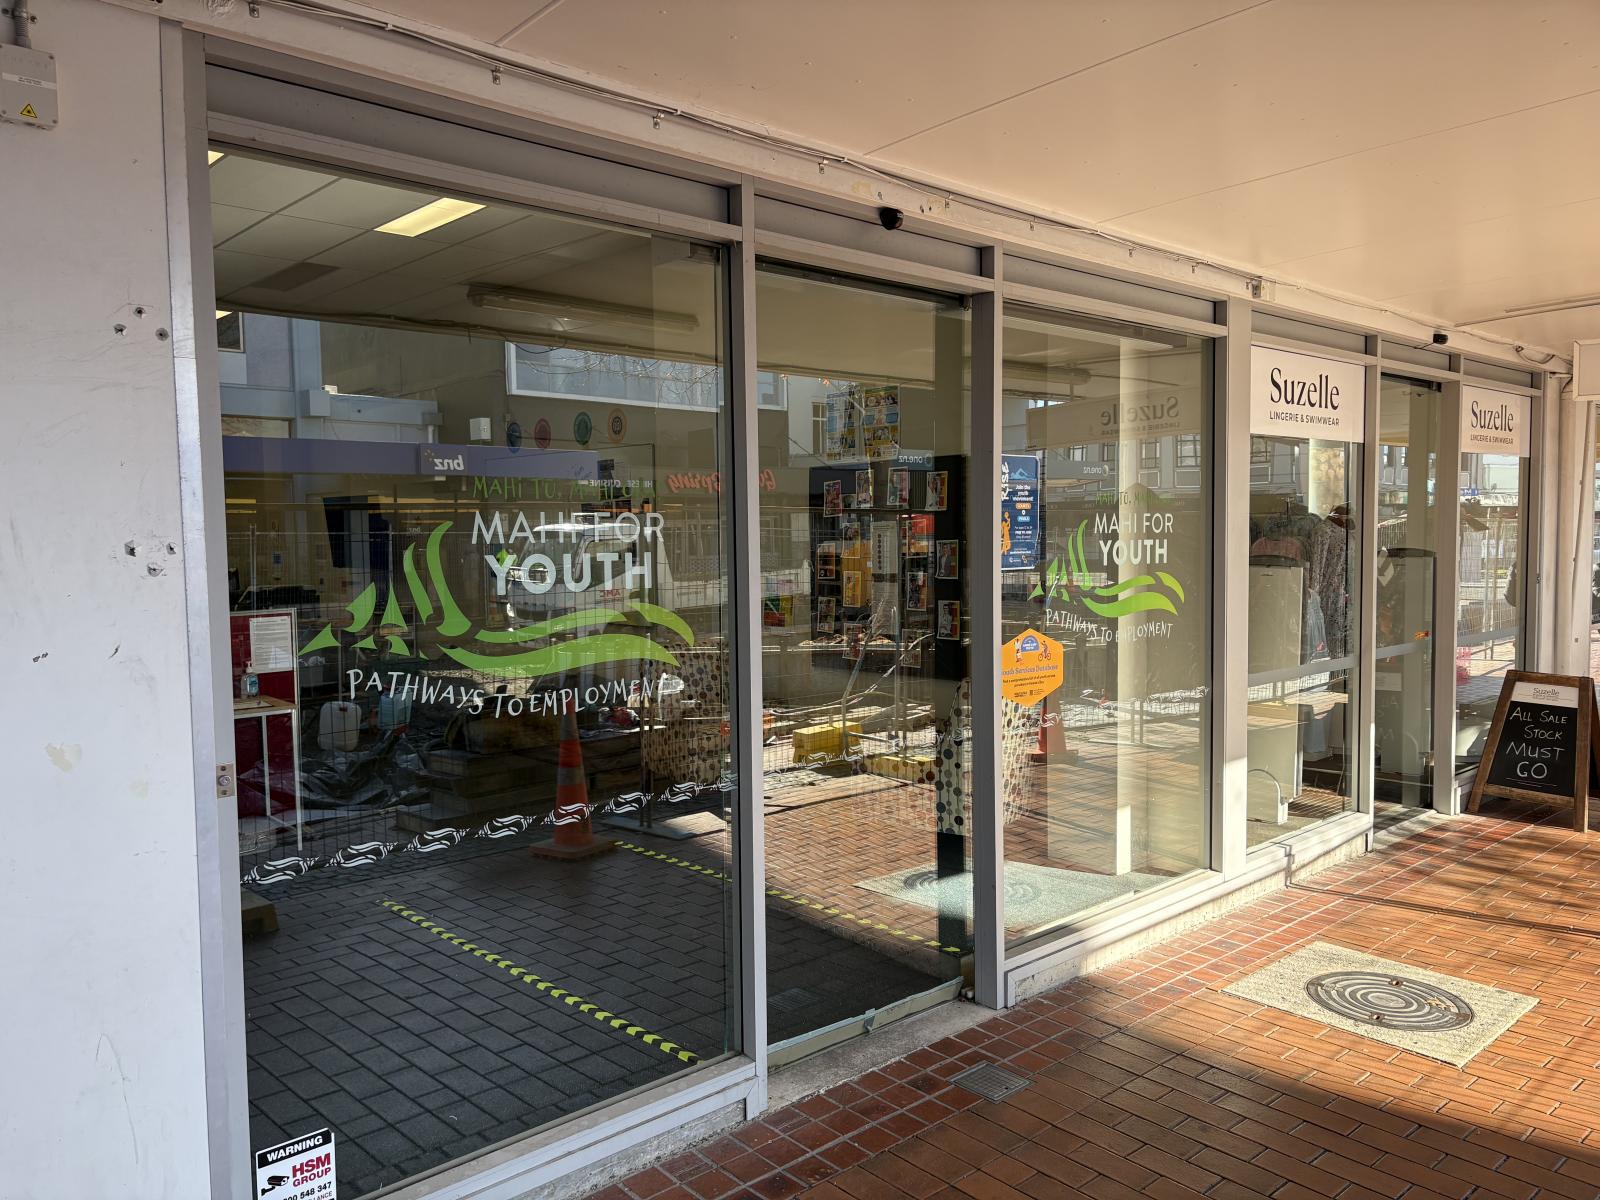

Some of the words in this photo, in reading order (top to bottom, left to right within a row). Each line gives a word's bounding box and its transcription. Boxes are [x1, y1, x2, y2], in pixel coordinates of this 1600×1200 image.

[1270, 367, 1340, 411] Suzelle
[1269, 410, 1299, 423] LINGERIE
[1300, 414, 1305, 423] &
[1305, 414, 1340, 426] SWIMWEAR
[1470, 400, 1514, 433] Suzelle
[471, 510, 577, 545] MAHI
[594, 511, 665, 545] FOR
[1094, 512, 1137, 534] MAHI
[1143, 512, 1174, 534] FOR
[1098, 538, 1168, 567] YOUTH
[484, 551, 652, 596] YOUTH
[1046, 608, 1098, 640] PATHWAYS
[1100, 626, 1113, 644] TO
[345, 668, 485, 716] PATHWAYS
[488, 693, 524, 719] TO
[1539, 710, 1568, 724] SALE
[1523, 724, 1563, 741] STOCK
[1505, 741, 1566, 761] MUST
[1516, 761, 1548, 779] GO
[266, 1135, 323, 1162] WARNING
[291, 1152, 331, 1178] HSM
[292, 1166, 332, 1188] GROUP
[299, 1187, 316, 1200] 548
[317, 1180, 333, 1192] 347
